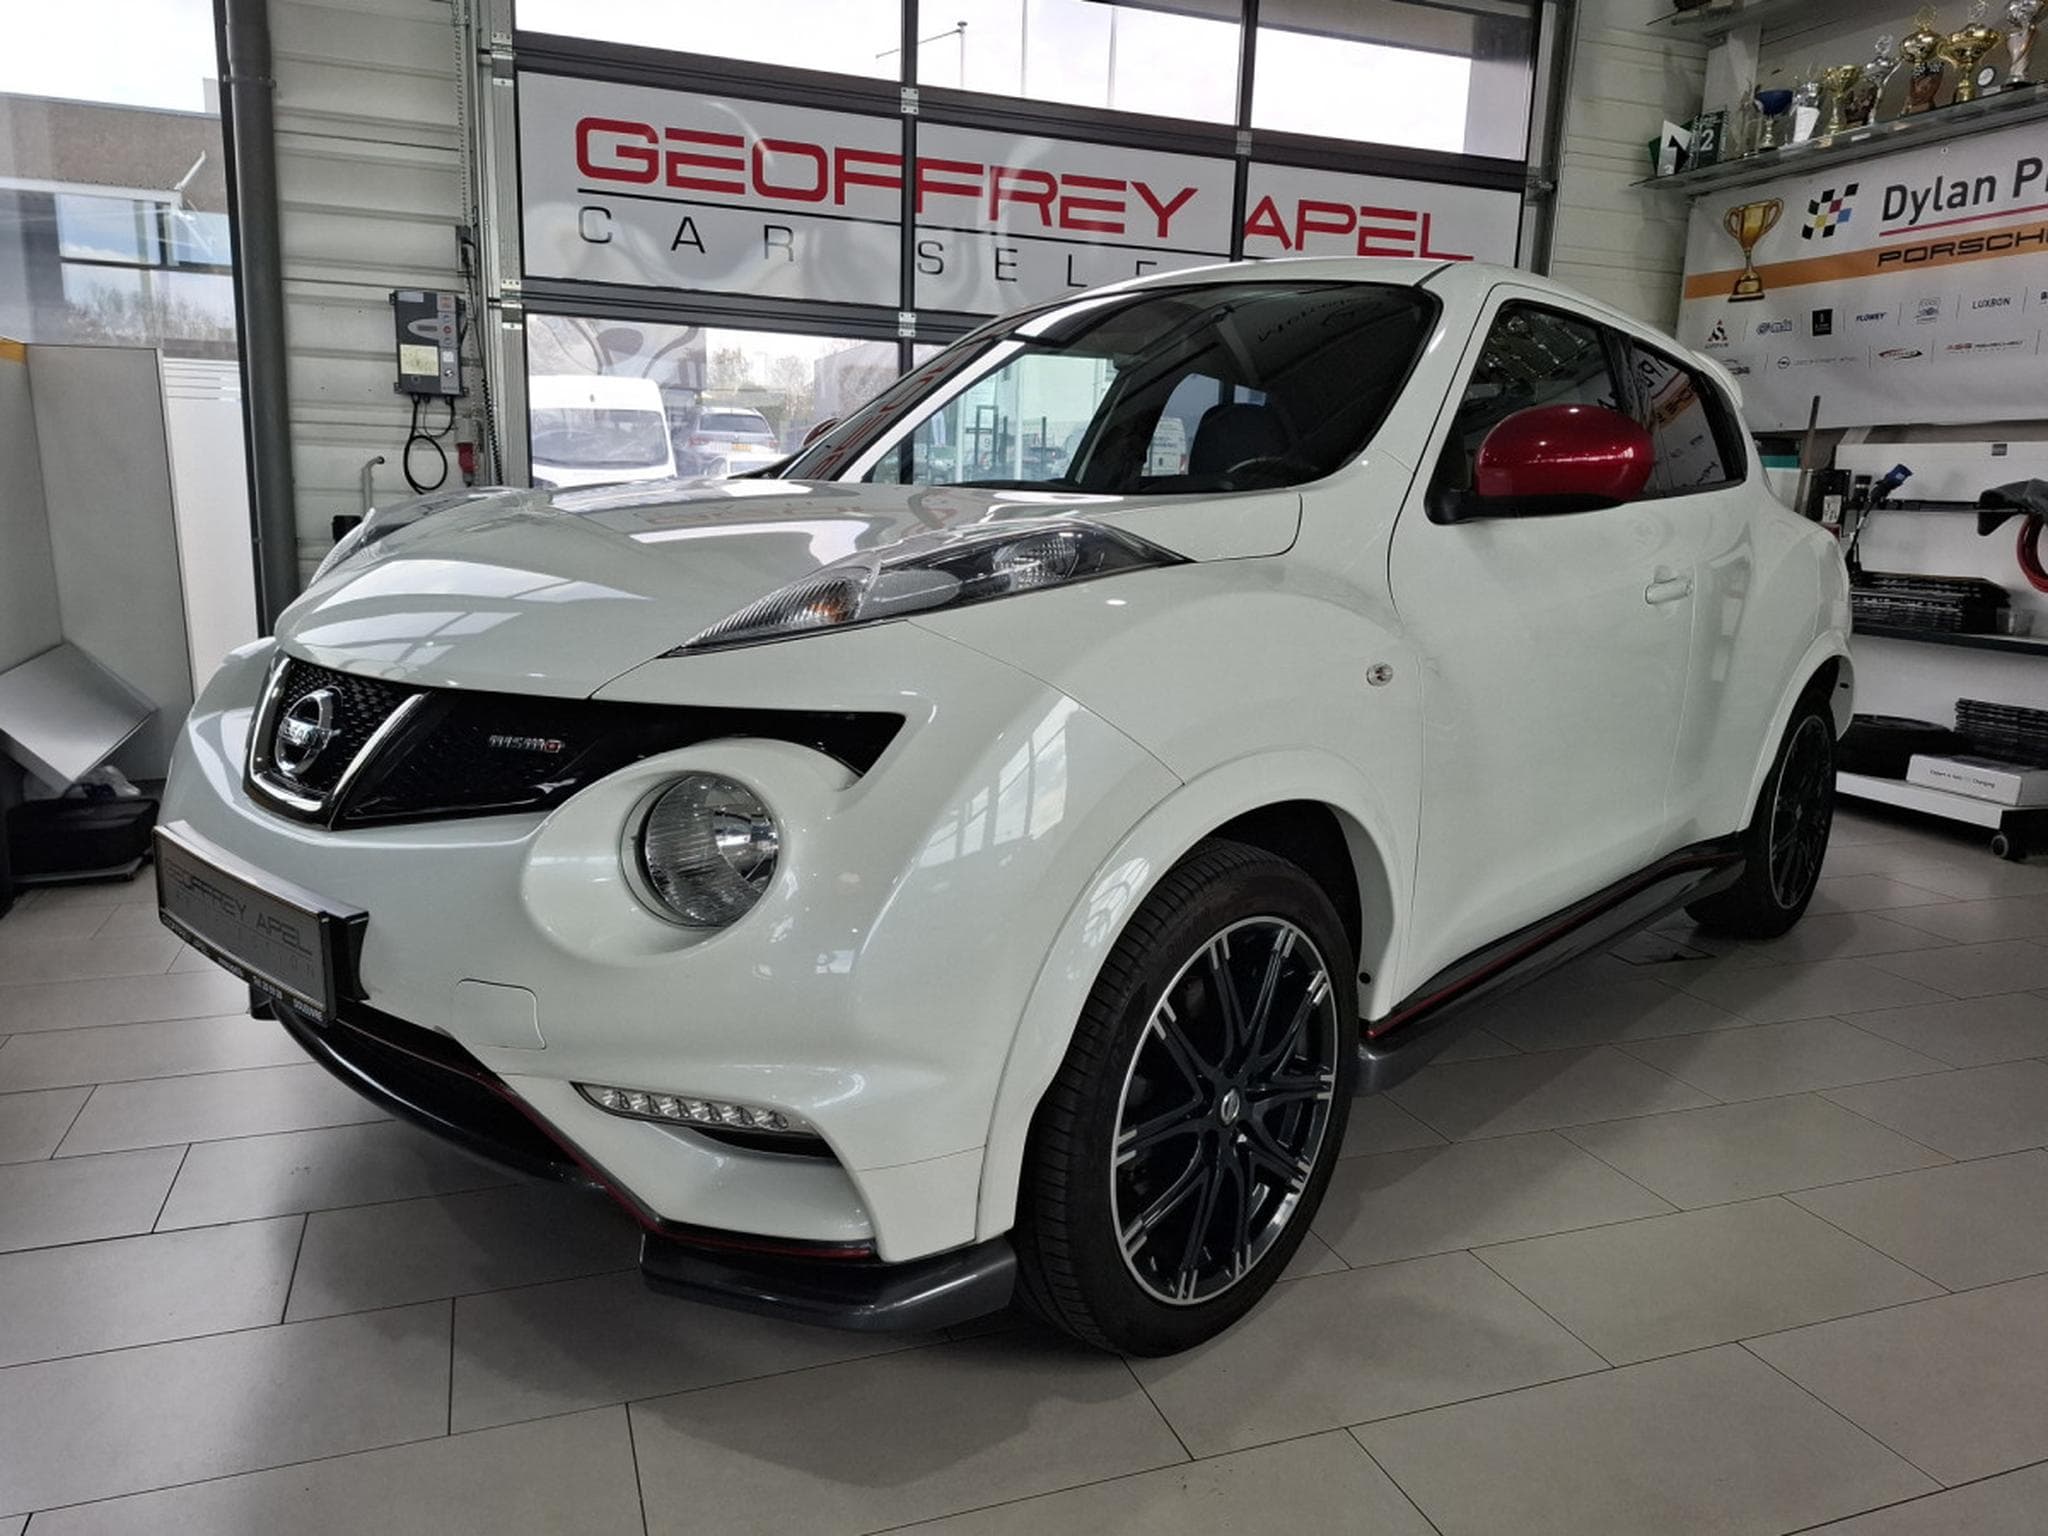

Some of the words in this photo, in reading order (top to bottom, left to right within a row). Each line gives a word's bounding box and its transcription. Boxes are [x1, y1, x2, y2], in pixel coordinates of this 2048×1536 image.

[575, 116, 1199, 239] GEOFFREY
[1243, 194, 1475, 262] APEL
[1881, 175, 1997, 226] Dylan
[2012, 156, 2048, 199] P
[577, 205, 795, 262] CAR
[1876, 227, 2048, 268] PORSCH
